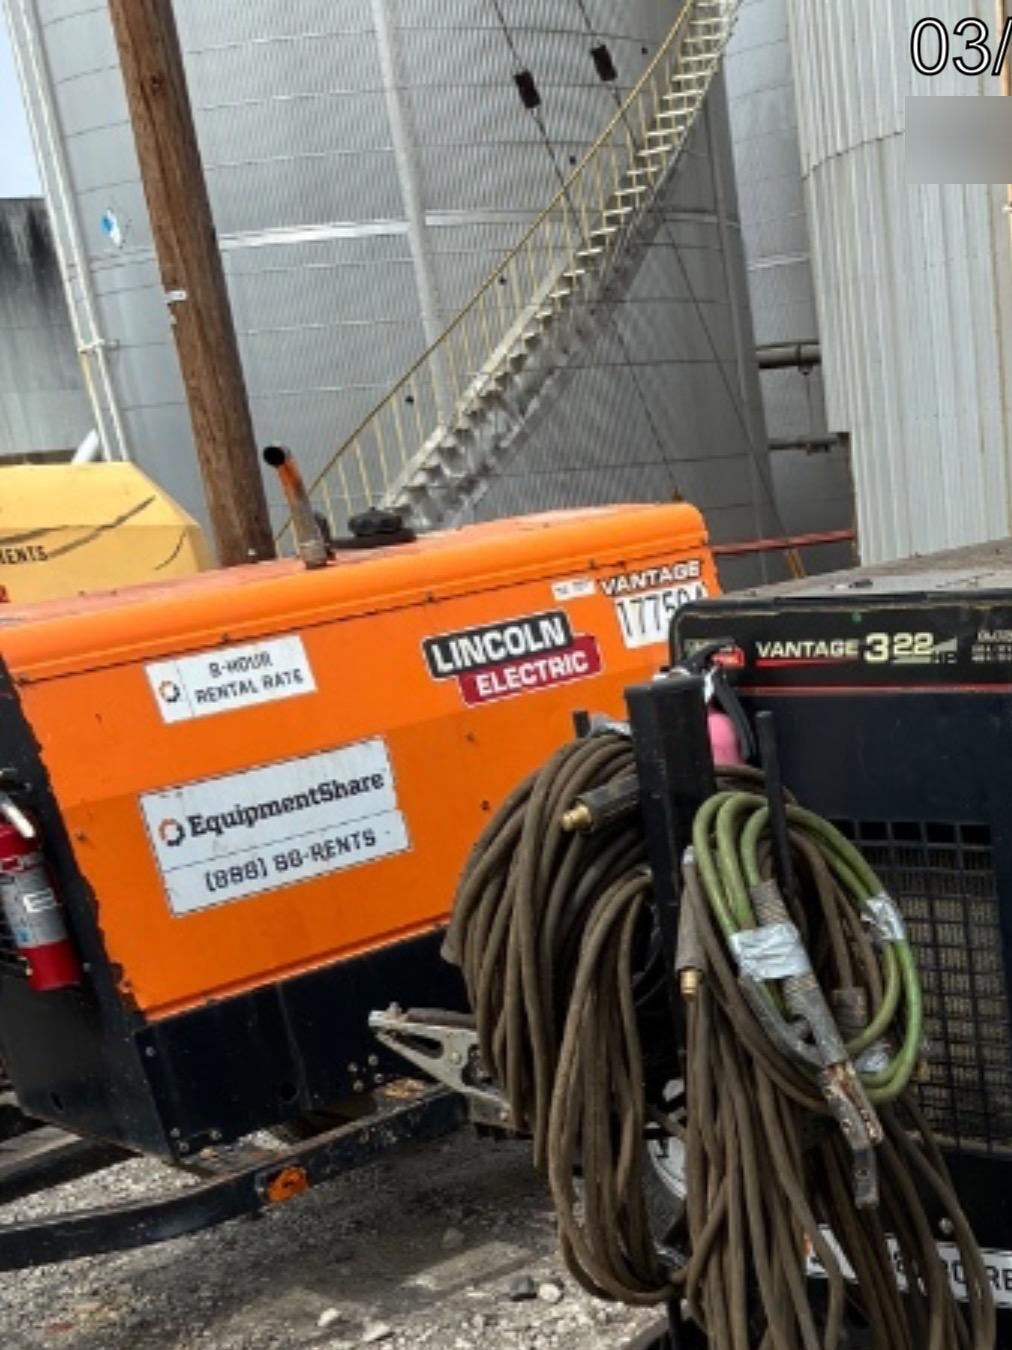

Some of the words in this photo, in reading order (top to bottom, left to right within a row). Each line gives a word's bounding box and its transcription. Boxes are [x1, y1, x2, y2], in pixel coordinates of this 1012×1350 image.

[601, 560, 700, 595] VANTAGE
[431, 617, 567, 673] LINCOLN
[756, 639, 860, 658] VANTAGE
[865, 632, 934, 664] 322
[209, 651, 273, 678] 8-HOUR
[475, 651, 589, 697] ELECTRIC
[195, 680, 258, 704] RENTAL
[262, 668, 304, 689] RATE
[187, 772, 385, 838] EquipmentShare
[205, 858, 268, 892] (888)
